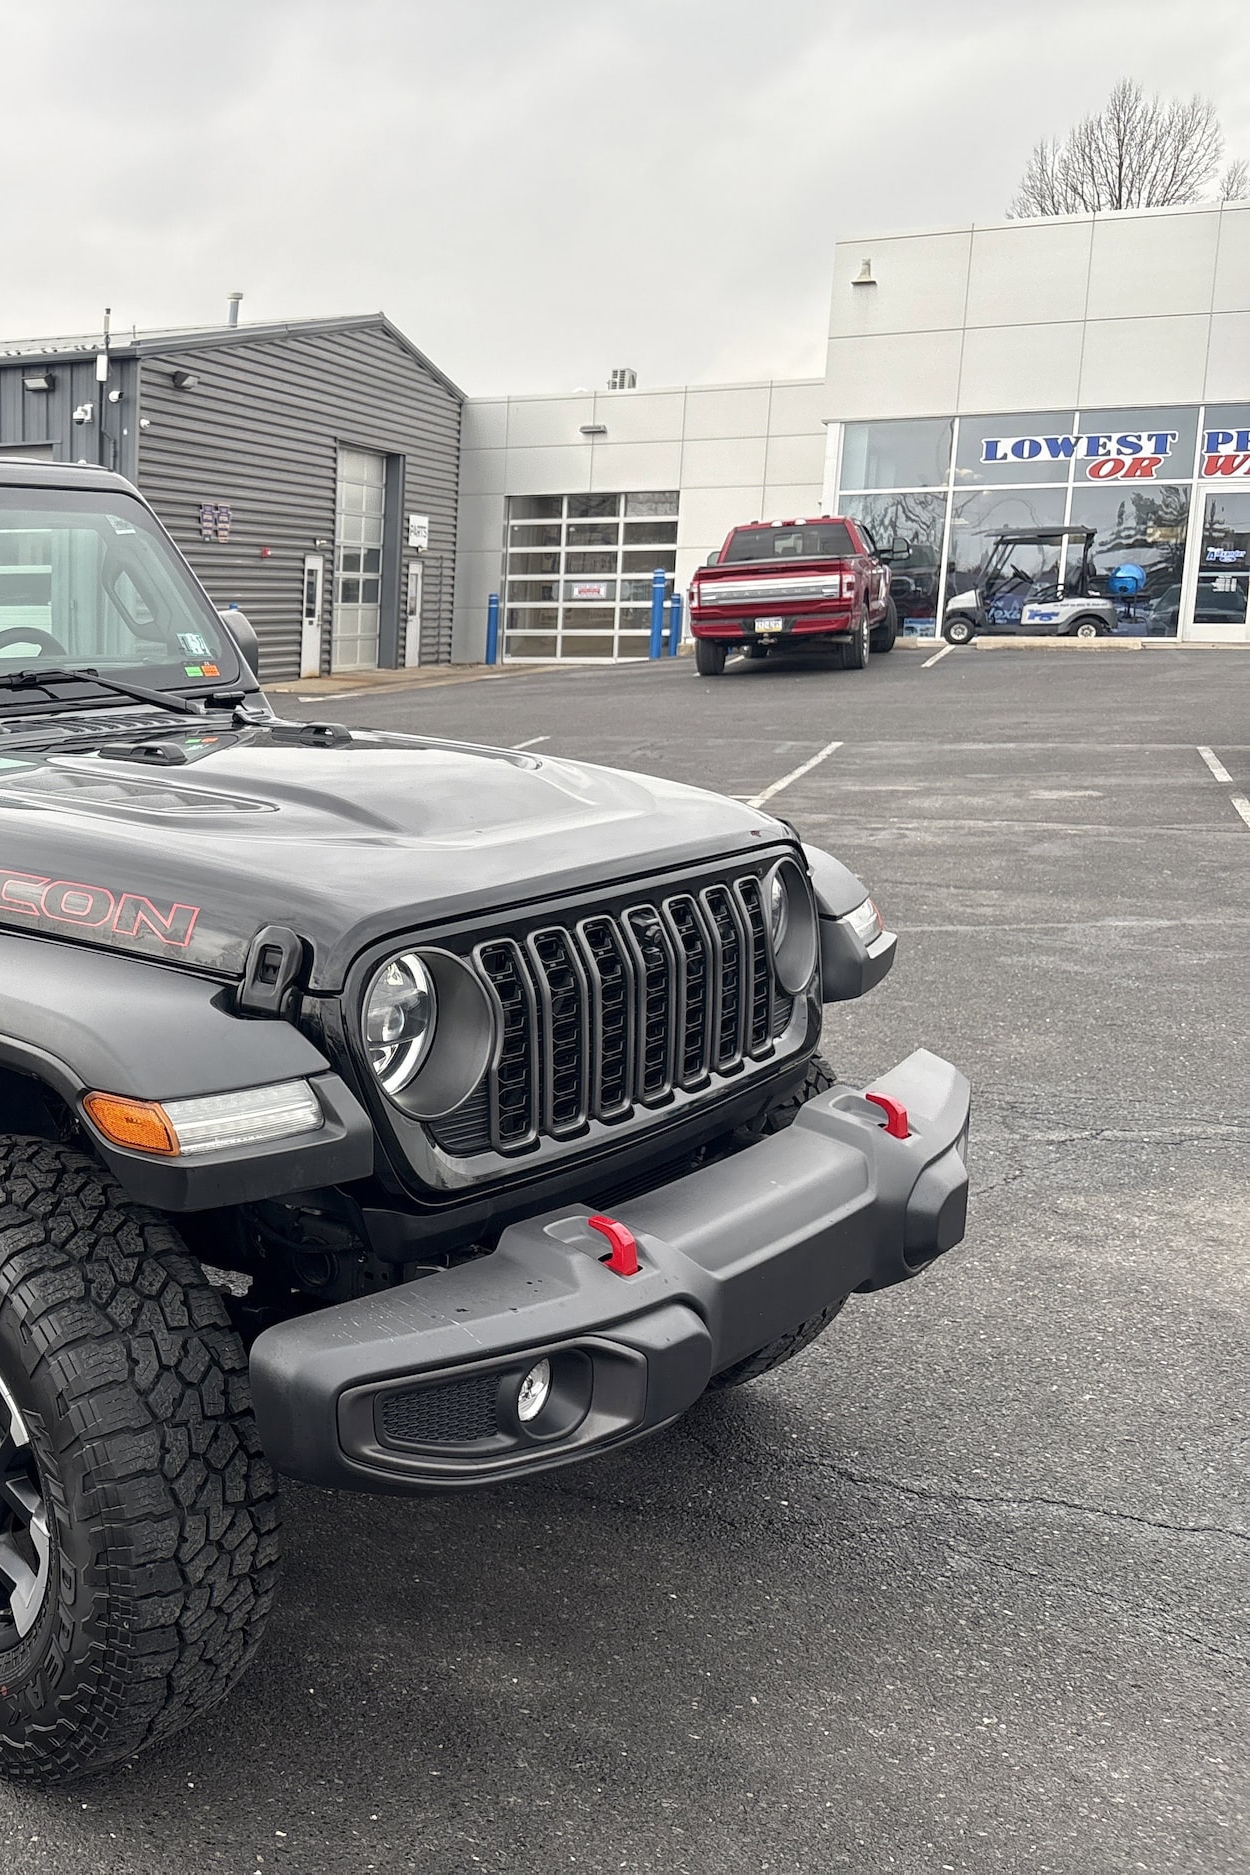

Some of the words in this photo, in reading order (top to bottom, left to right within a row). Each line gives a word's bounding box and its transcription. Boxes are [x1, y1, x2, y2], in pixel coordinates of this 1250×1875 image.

[982, 432, 1177, 462] LOWEST
[1088, 456, 1162, 479] OR
[1204, 454, 1250, 476] W
